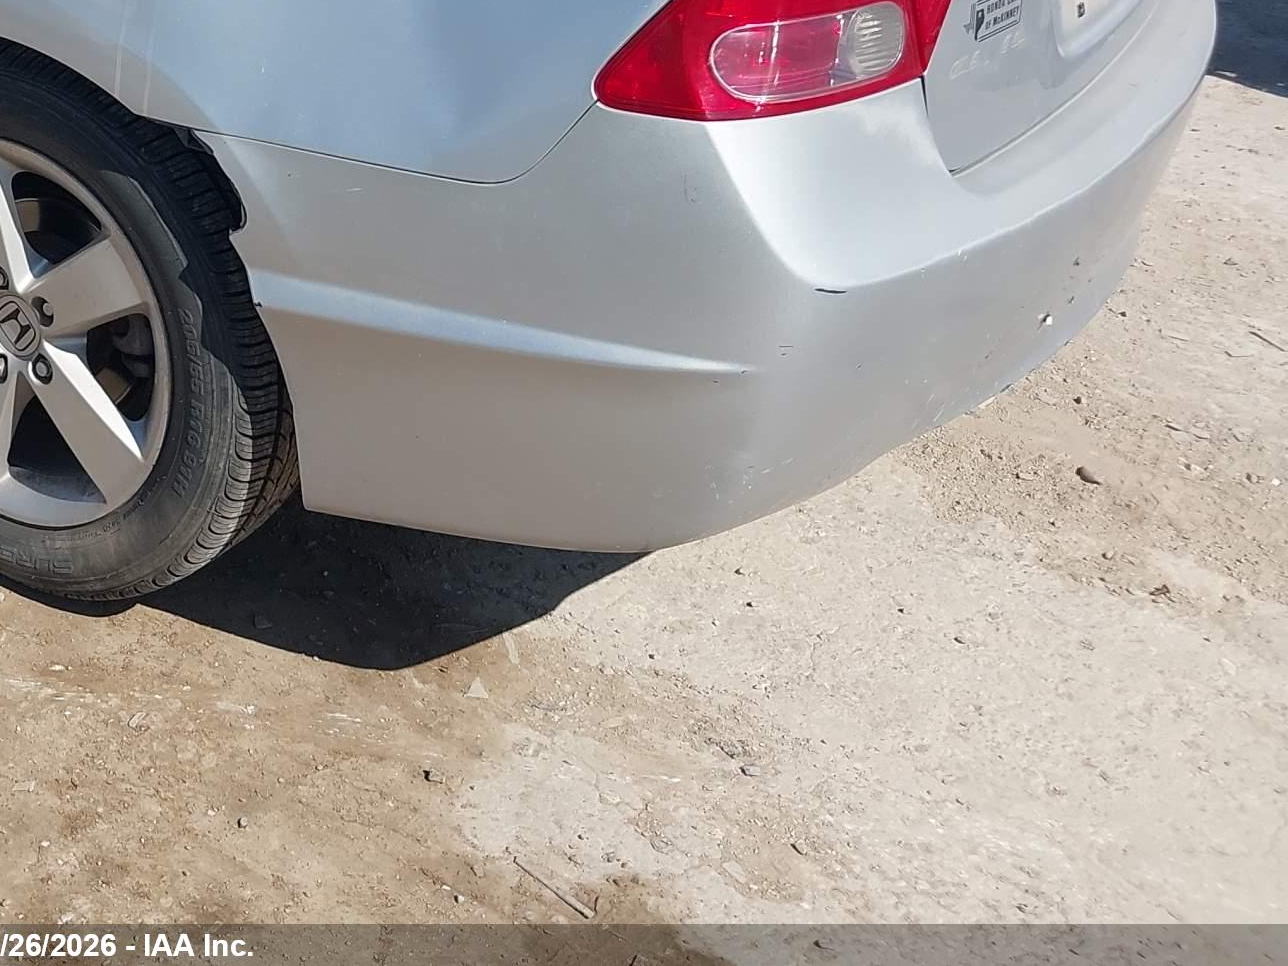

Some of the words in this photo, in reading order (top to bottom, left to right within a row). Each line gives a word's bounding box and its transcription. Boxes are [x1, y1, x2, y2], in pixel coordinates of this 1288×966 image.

[985, 20, 992, 30] OF
[993, 6, 1019, 25] McKINNEY
[177, 307, 204, 396] 205/55
[184, 399, 205, 448] R16
[172, 453, 198, 498] 91H
